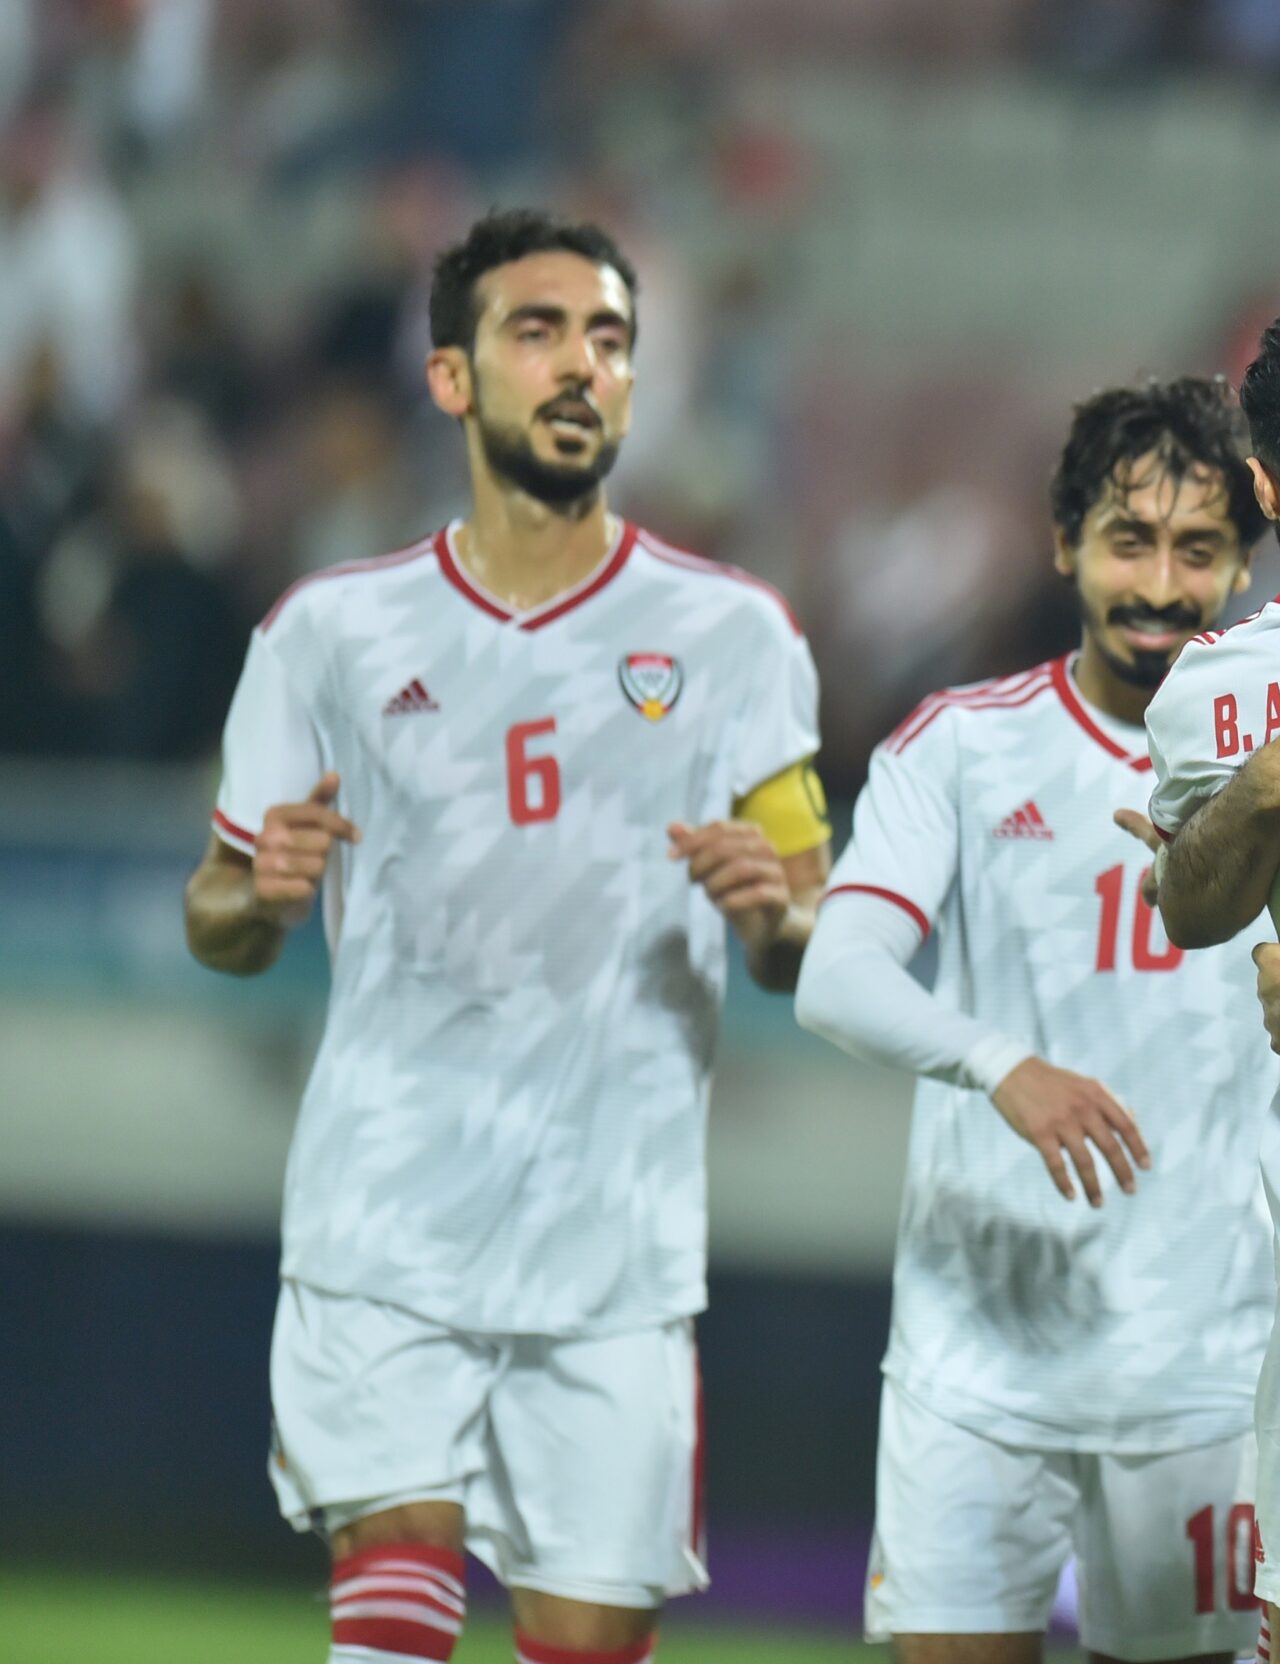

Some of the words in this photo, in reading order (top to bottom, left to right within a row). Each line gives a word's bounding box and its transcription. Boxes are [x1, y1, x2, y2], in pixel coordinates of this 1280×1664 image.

[505, 715, 562, 828] 6
[1213, 692, 1254, 759] B.
[1093, 862, 1185, 973] 10
[1186, 1502, 1261, 1615] 10
